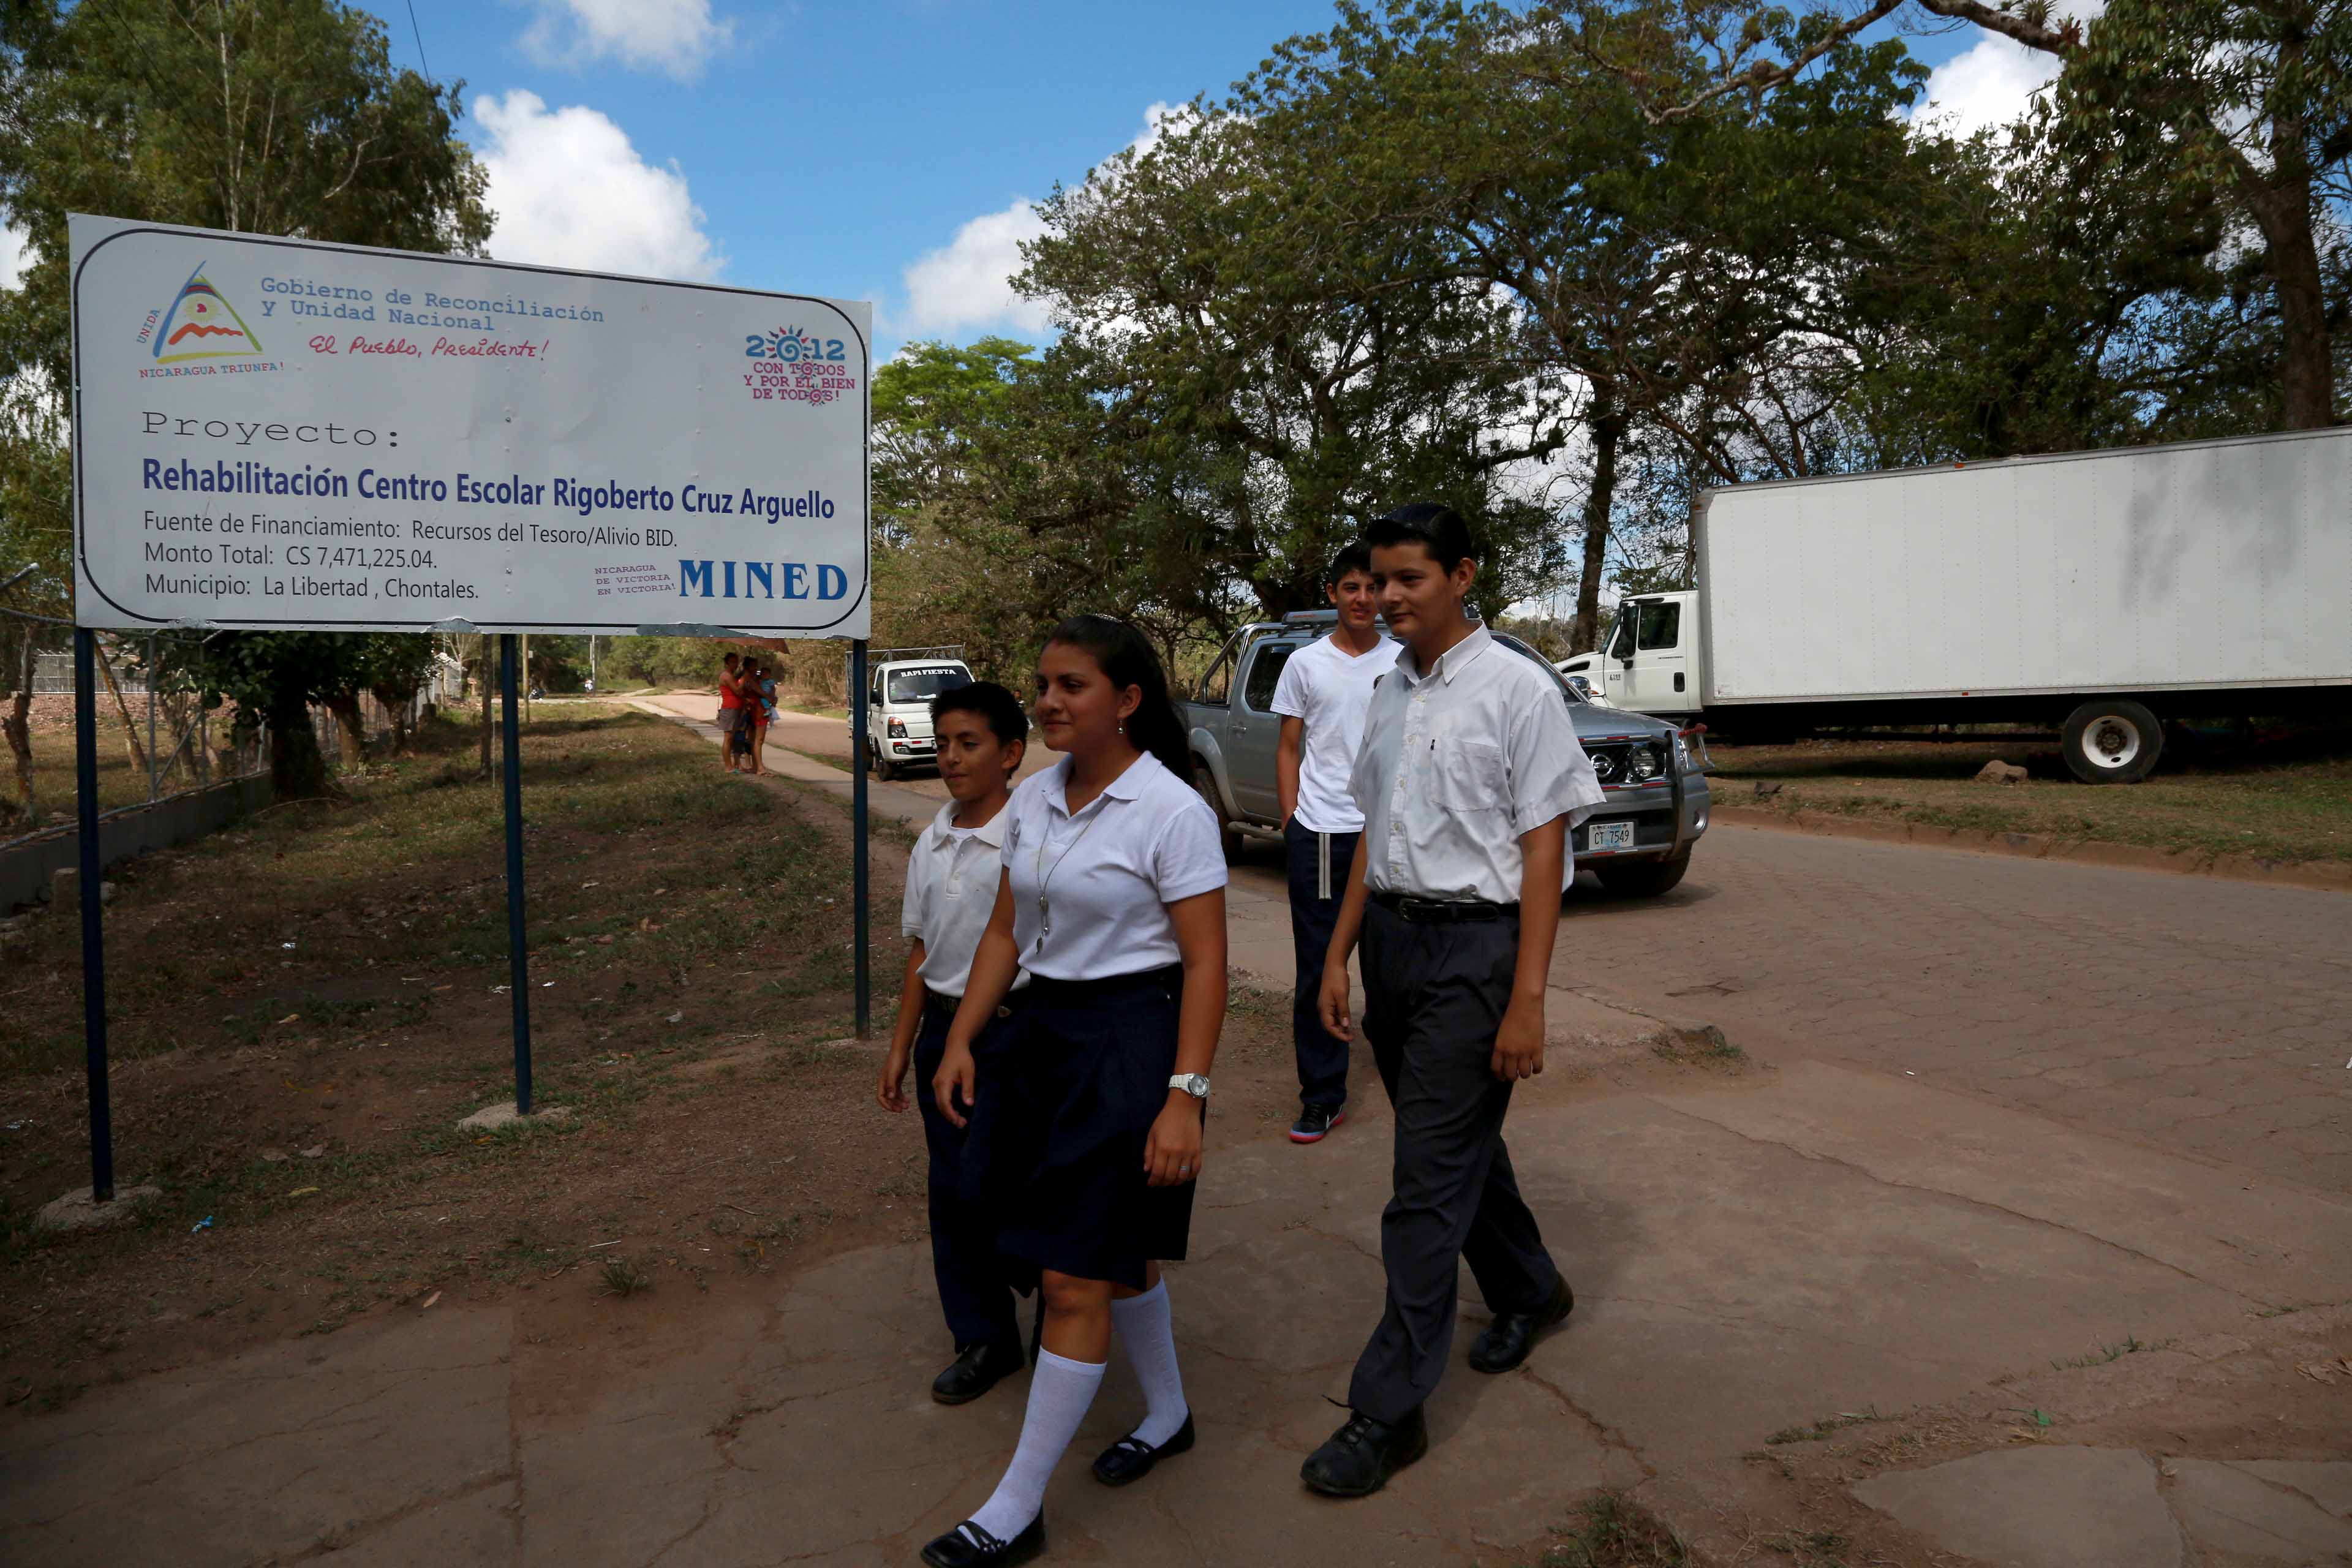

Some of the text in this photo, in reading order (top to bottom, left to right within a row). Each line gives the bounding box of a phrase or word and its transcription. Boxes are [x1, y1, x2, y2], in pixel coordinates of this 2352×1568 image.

[261, 277, 604, 322] Gobierno de Reconciliación
[290, 300, 375, 321] Unidad
[388, 309, 495, 331] Nacional
[309, 336, 338, 354] El
[745, 334, 845, 362] 2012
[139, 362, 284, 378] NICARAGUA TRIUNFA!
[753, 362, 845, 376] CON TODOS
[744, 375, 856, 390] Y POR EL BIEN
[753, 388, 840, 402] DE TODOS!
[142, 412, 398, 447] Proyecto:
[143, 458, 834, 524] Rehabilitación Centro Escolar Rigoberto Cruz Arguello
[144, 510, 677, 547] Fuente de Financiamiento: Recursos del Tesoro/Alivio BID.
[145, 542, 213, 563] Monto
[219, 545, 273, 564] Total:
[317, 547, 437, 570] 7,471,225.04.
[595, 565, 656, 574] NICARAGUA
[617, 574, 671, 583] VICTORIA
[679, 560, 848, 600] MINED
[146, 574, 250, 600] Municipio:
[265, 576, 284, 595] La
[385, 578, 478, 598] Chontales.
[1594, 829, 1629, 844] CT 7549
